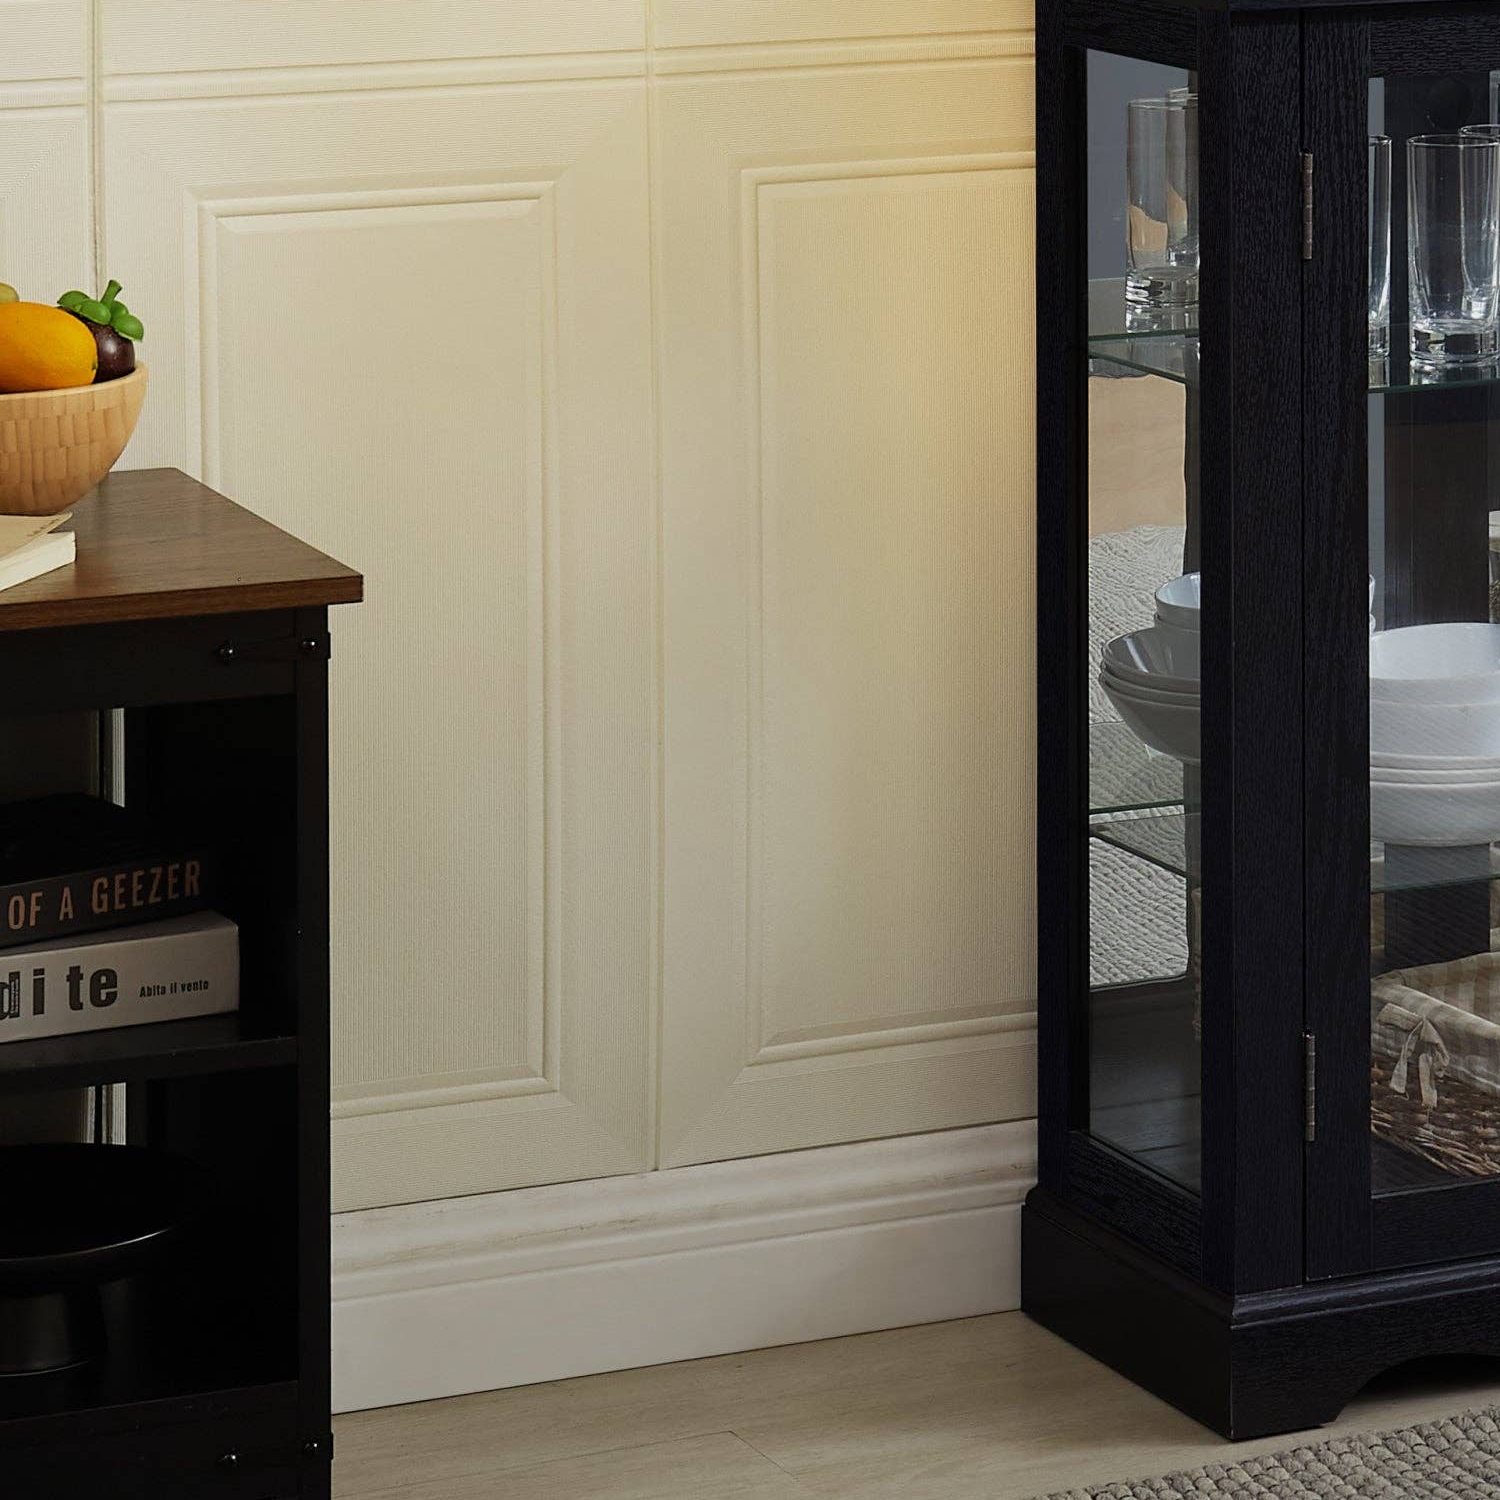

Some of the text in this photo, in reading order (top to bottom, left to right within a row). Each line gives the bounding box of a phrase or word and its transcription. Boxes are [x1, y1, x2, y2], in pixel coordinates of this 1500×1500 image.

[8, 860, 201, 930] OF A GEEZER
[139, 979, 209, 998] Abita il vento
